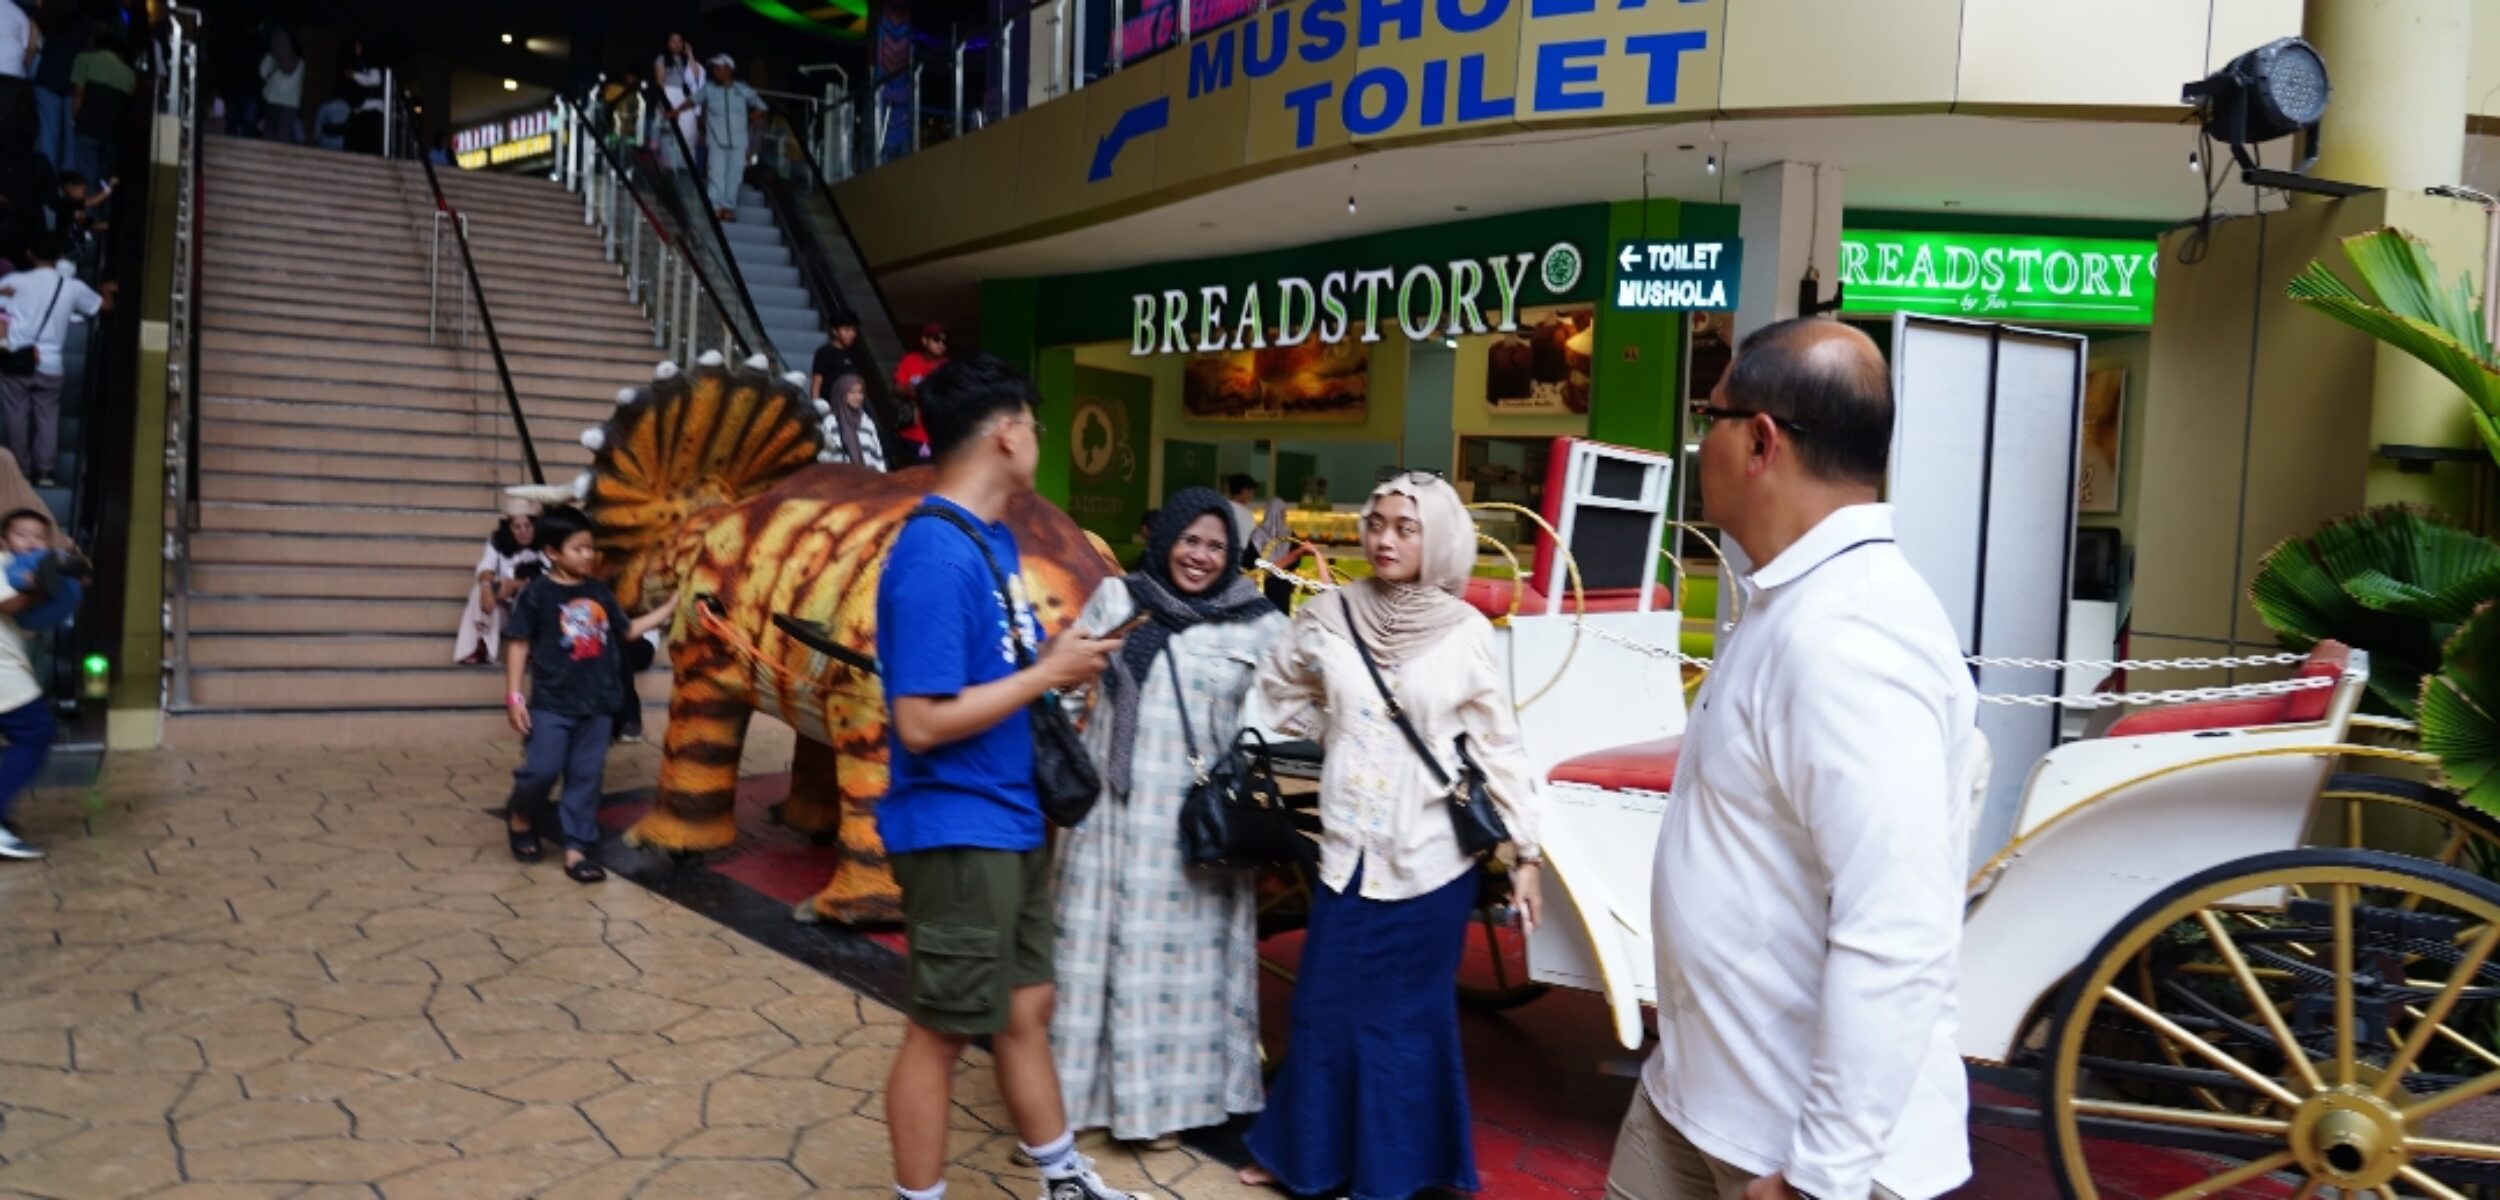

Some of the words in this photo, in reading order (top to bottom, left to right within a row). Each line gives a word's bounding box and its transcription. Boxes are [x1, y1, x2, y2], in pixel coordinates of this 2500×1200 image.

[1187, 0, 1691, 98] MUSHO
[1284, 30, 1707, 149] TOILET
[1617, 279, 1727, 307] MUSHOLA
[1647, 243, 1723, 271] TOILET
[1838, 241, 2143, 298] READSTORY
[1130, 252, 1535, 356] BREADSTORY
